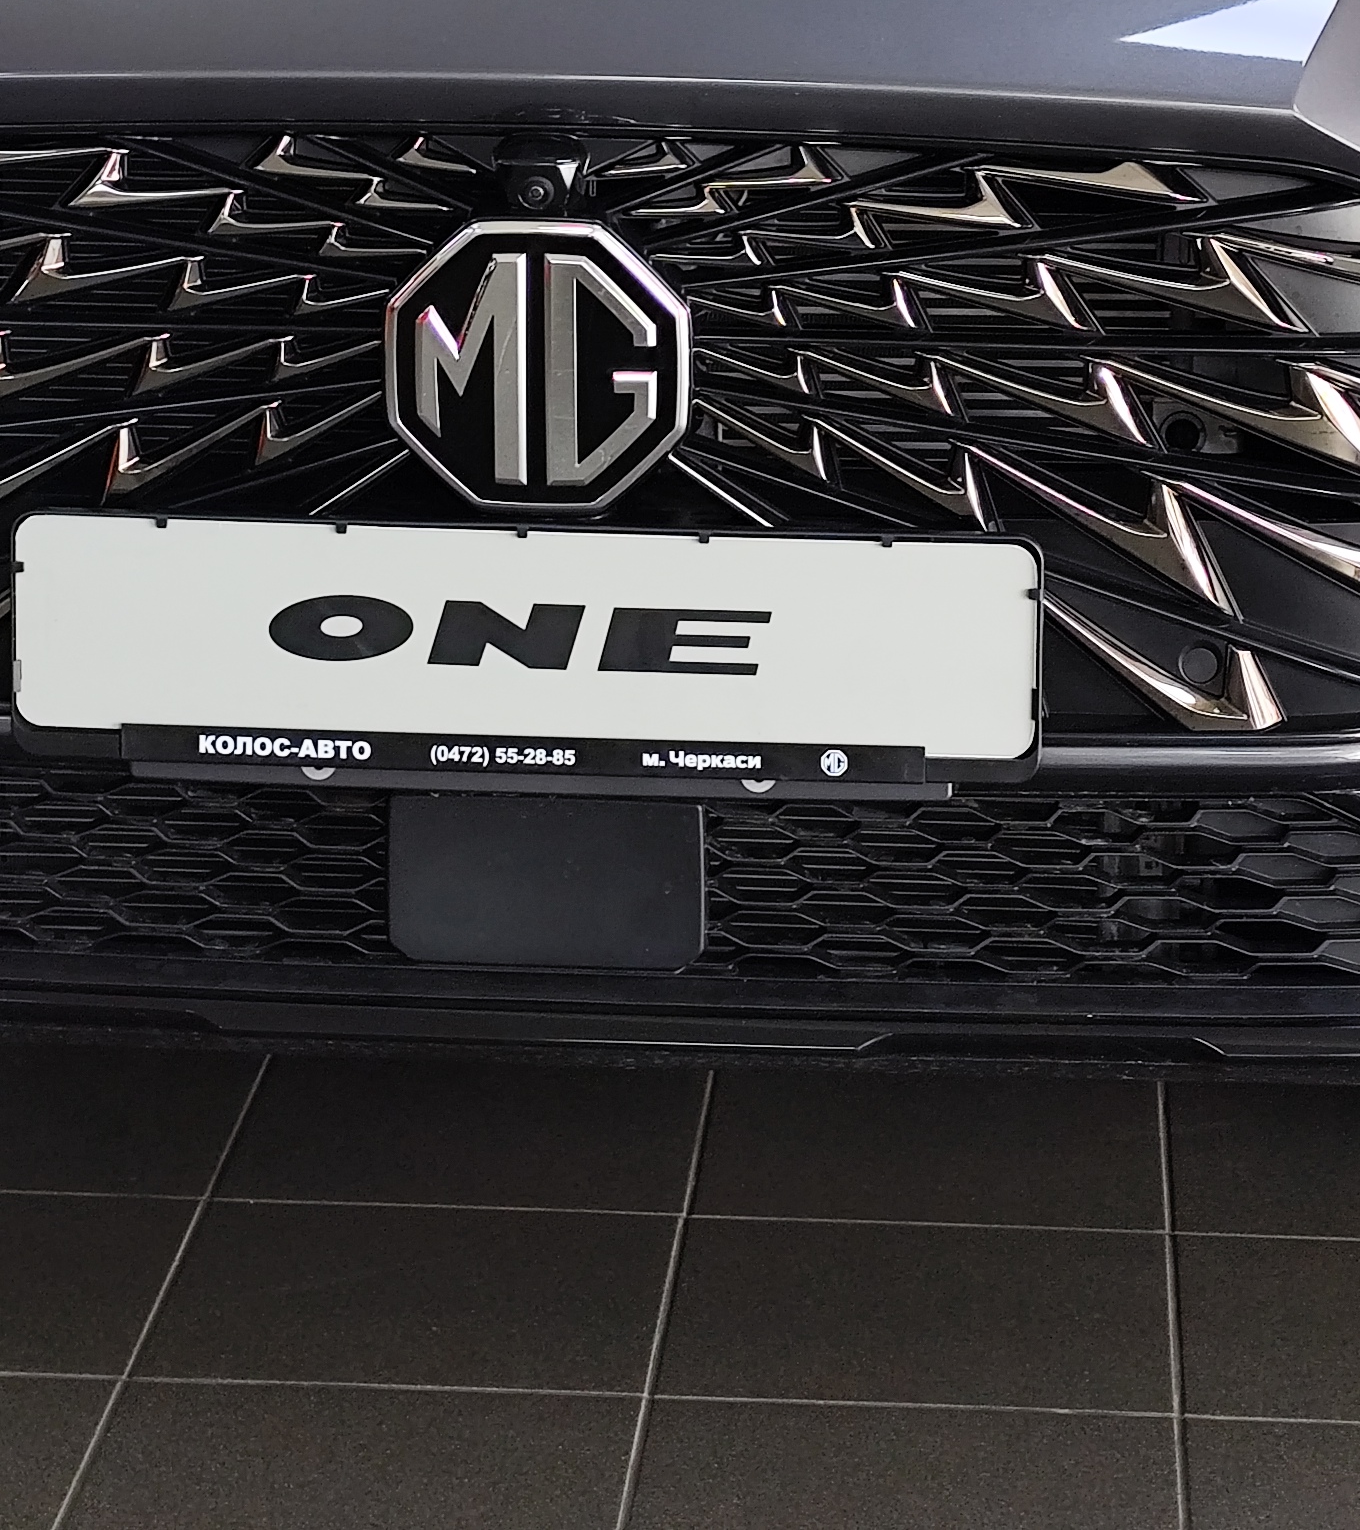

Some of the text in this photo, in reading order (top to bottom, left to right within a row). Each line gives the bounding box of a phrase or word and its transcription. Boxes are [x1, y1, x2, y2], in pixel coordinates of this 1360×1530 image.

[416, 252, 658, 486] MG
[269, 593, 772, 676] ONE
[198, 734, 372, 761] КОЛОС-АВТО
[430, 744, 490, 767] (0472)
[494, 747, 576, 767] 55-28-85
[642, 750, 666, 767] м.
[669, 750, 762, 771] Черкаси
